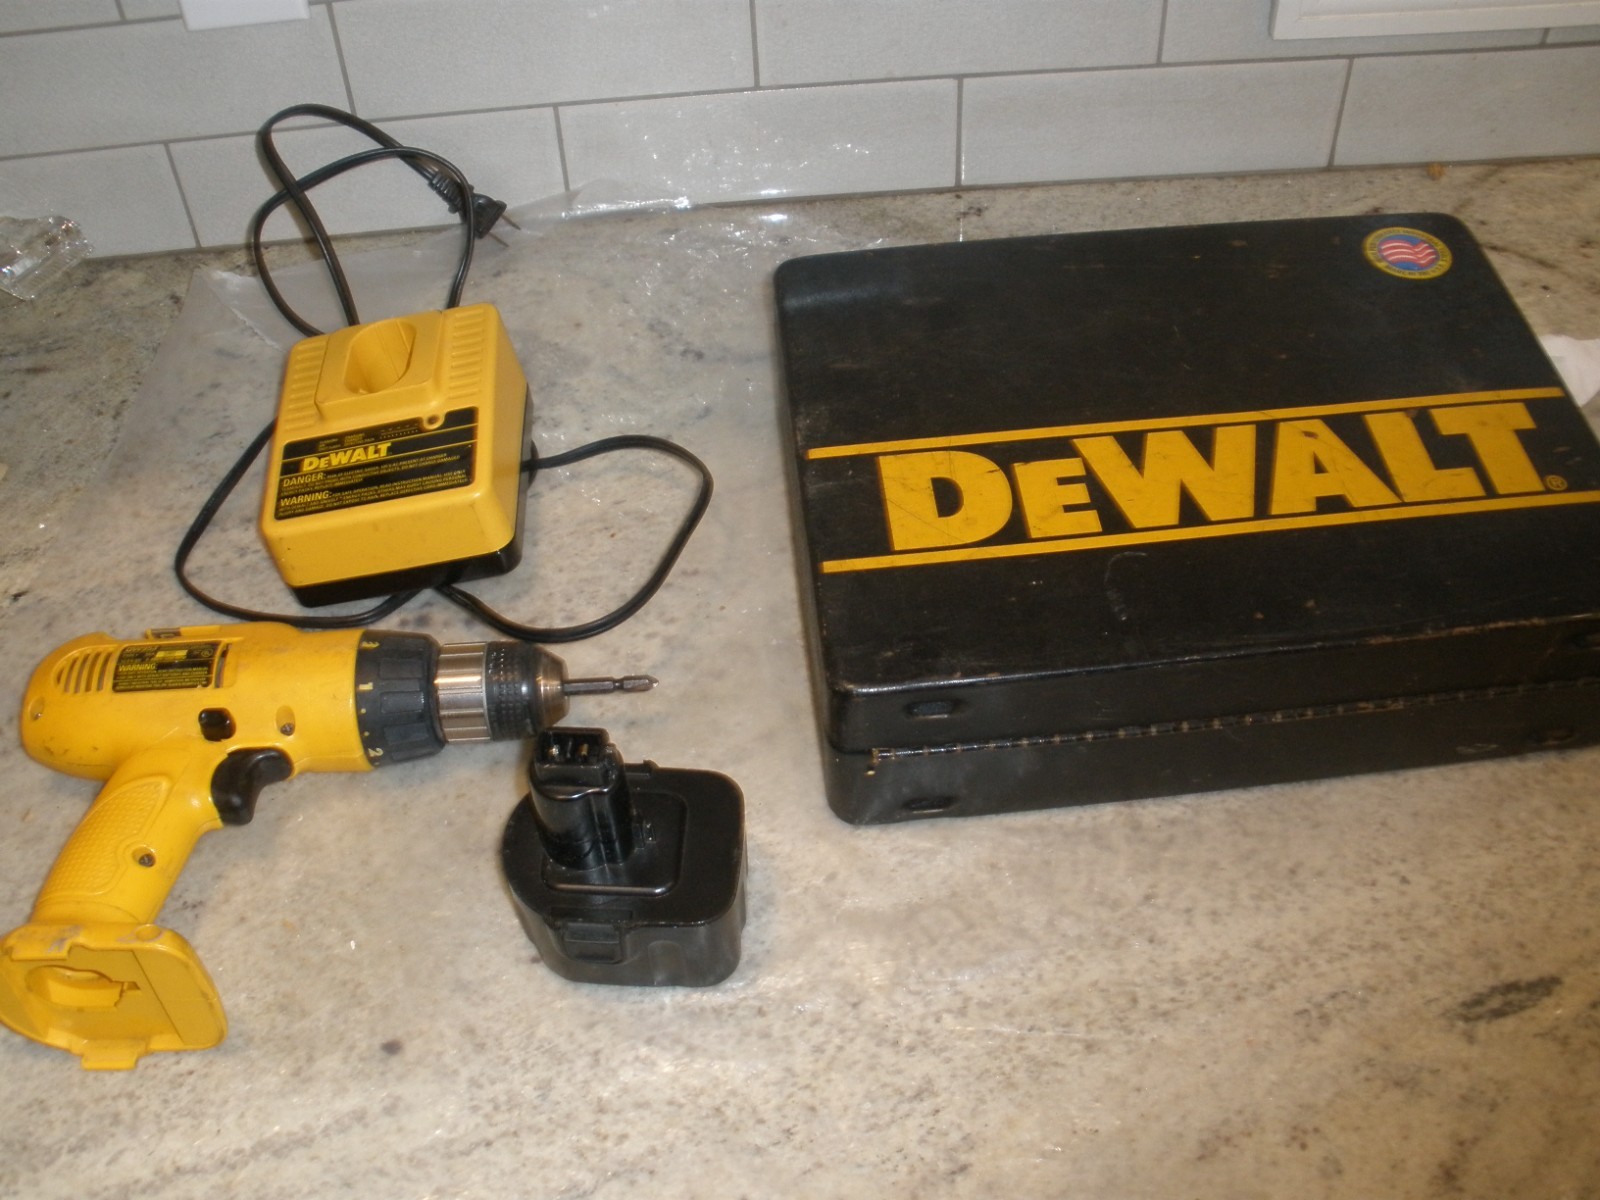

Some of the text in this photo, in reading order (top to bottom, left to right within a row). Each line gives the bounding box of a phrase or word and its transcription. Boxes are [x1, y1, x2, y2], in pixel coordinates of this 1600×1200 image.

[303, 442, 391, 471] DEWALT
[283, 472, 326, 487] DANGER:
[876, 402, 1547, 552] DEWALT
[280, 490, 332, 507] WARNING:
[359, 682, 374, 691] 1
[367, 747, 384, 757] 2
